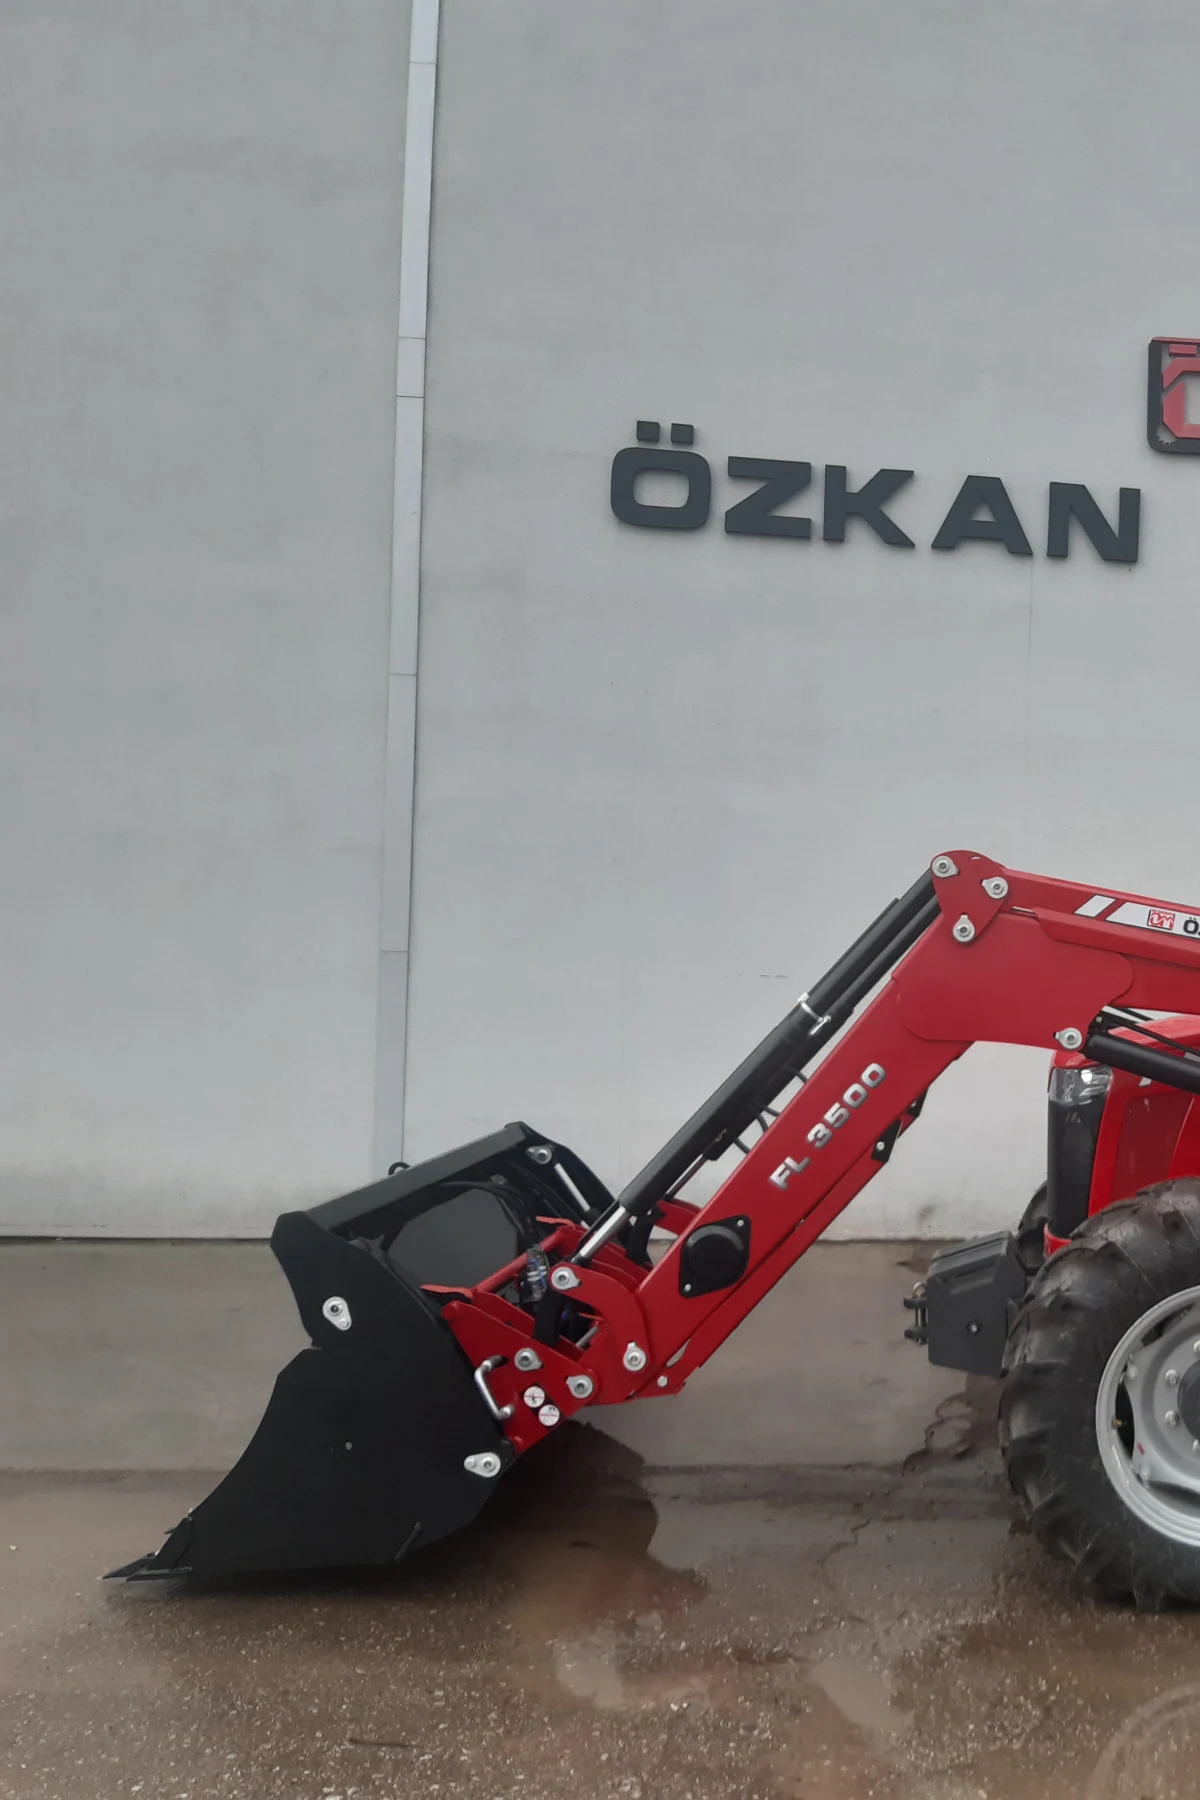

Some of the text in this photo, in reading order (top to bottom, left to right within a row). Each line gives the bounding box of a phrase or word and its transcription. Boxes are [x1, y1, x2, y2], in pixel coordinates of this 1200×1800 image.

[610, 420, 1141, 563] ÖZKAN
[769, 1062, 887, 1191] FL 3500
